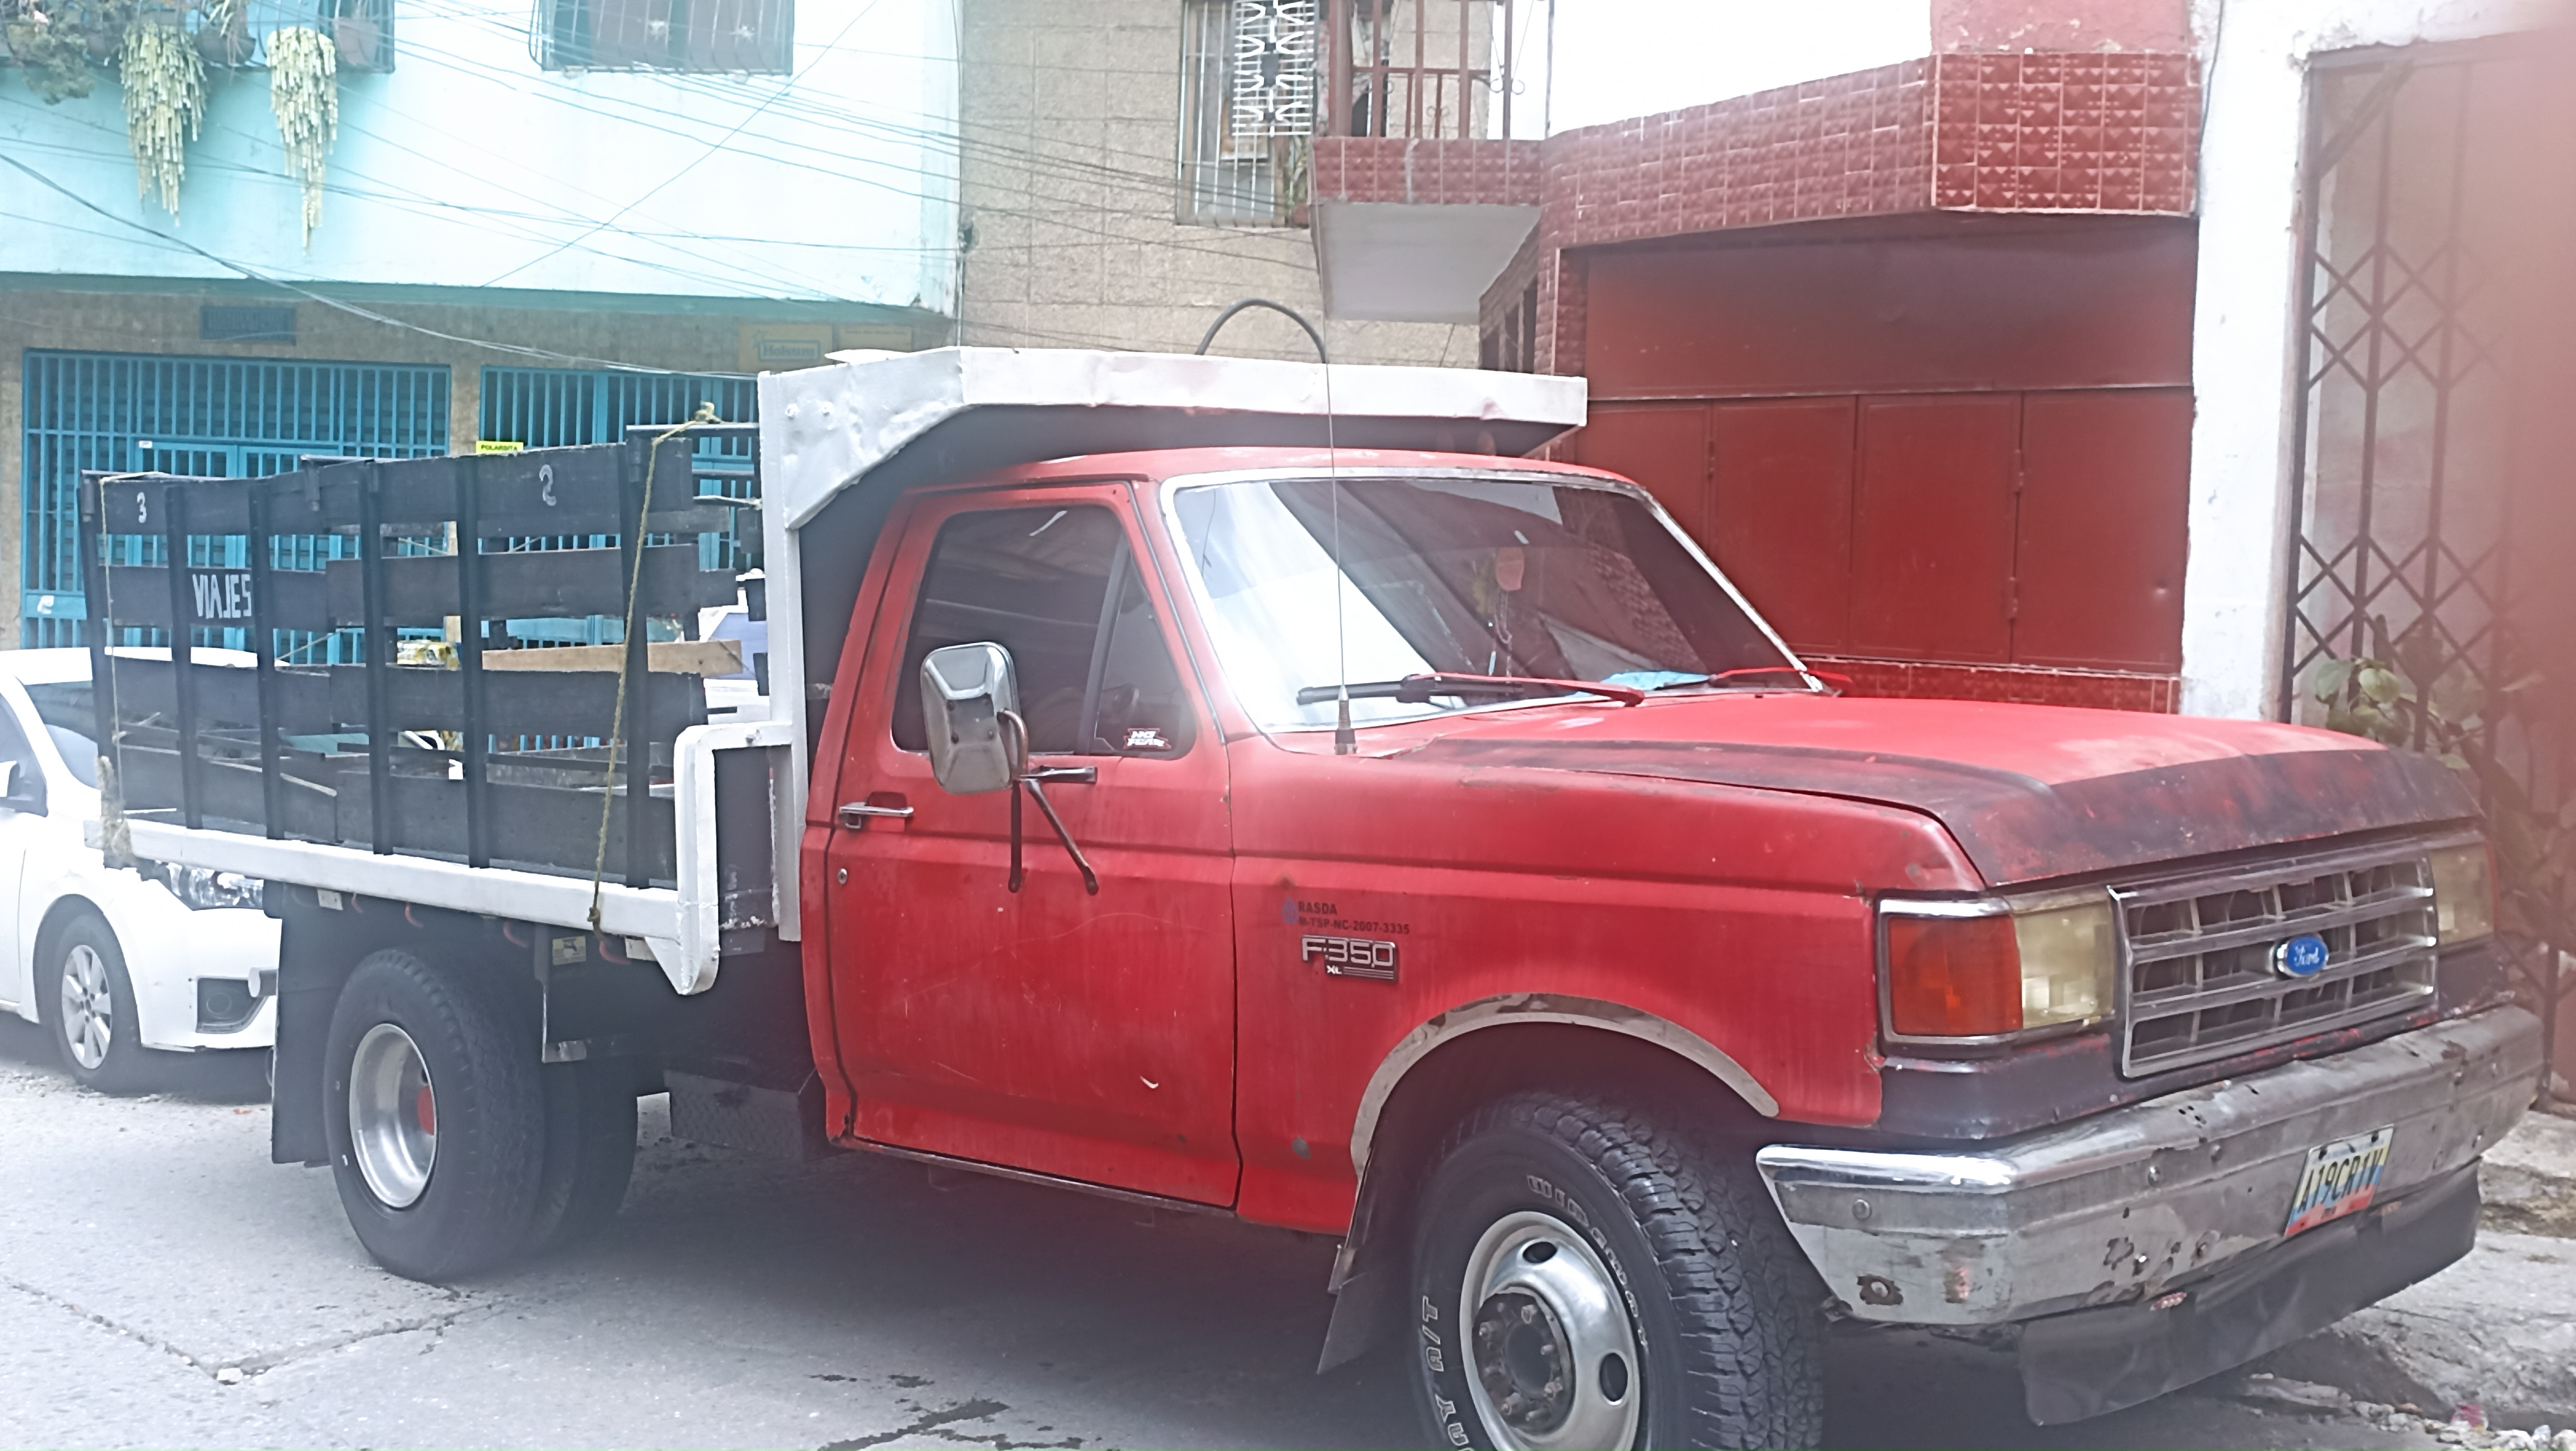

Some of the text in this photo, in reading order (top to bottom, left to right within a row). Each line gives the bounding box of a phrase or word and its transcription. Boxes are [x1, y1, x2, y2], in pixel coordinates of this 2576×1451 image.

[539, 464, 557, 506] 2
[137, 492, 147, 523] 3
[192, 574, 252, 619] VIAJES
[1298, 901, 1338, 915] RASDA
[1326, 965, 1342, 975] XL
[2294, 945, 2320, 967] Ford
[1422, 1294, 1444, 1372] A/T
